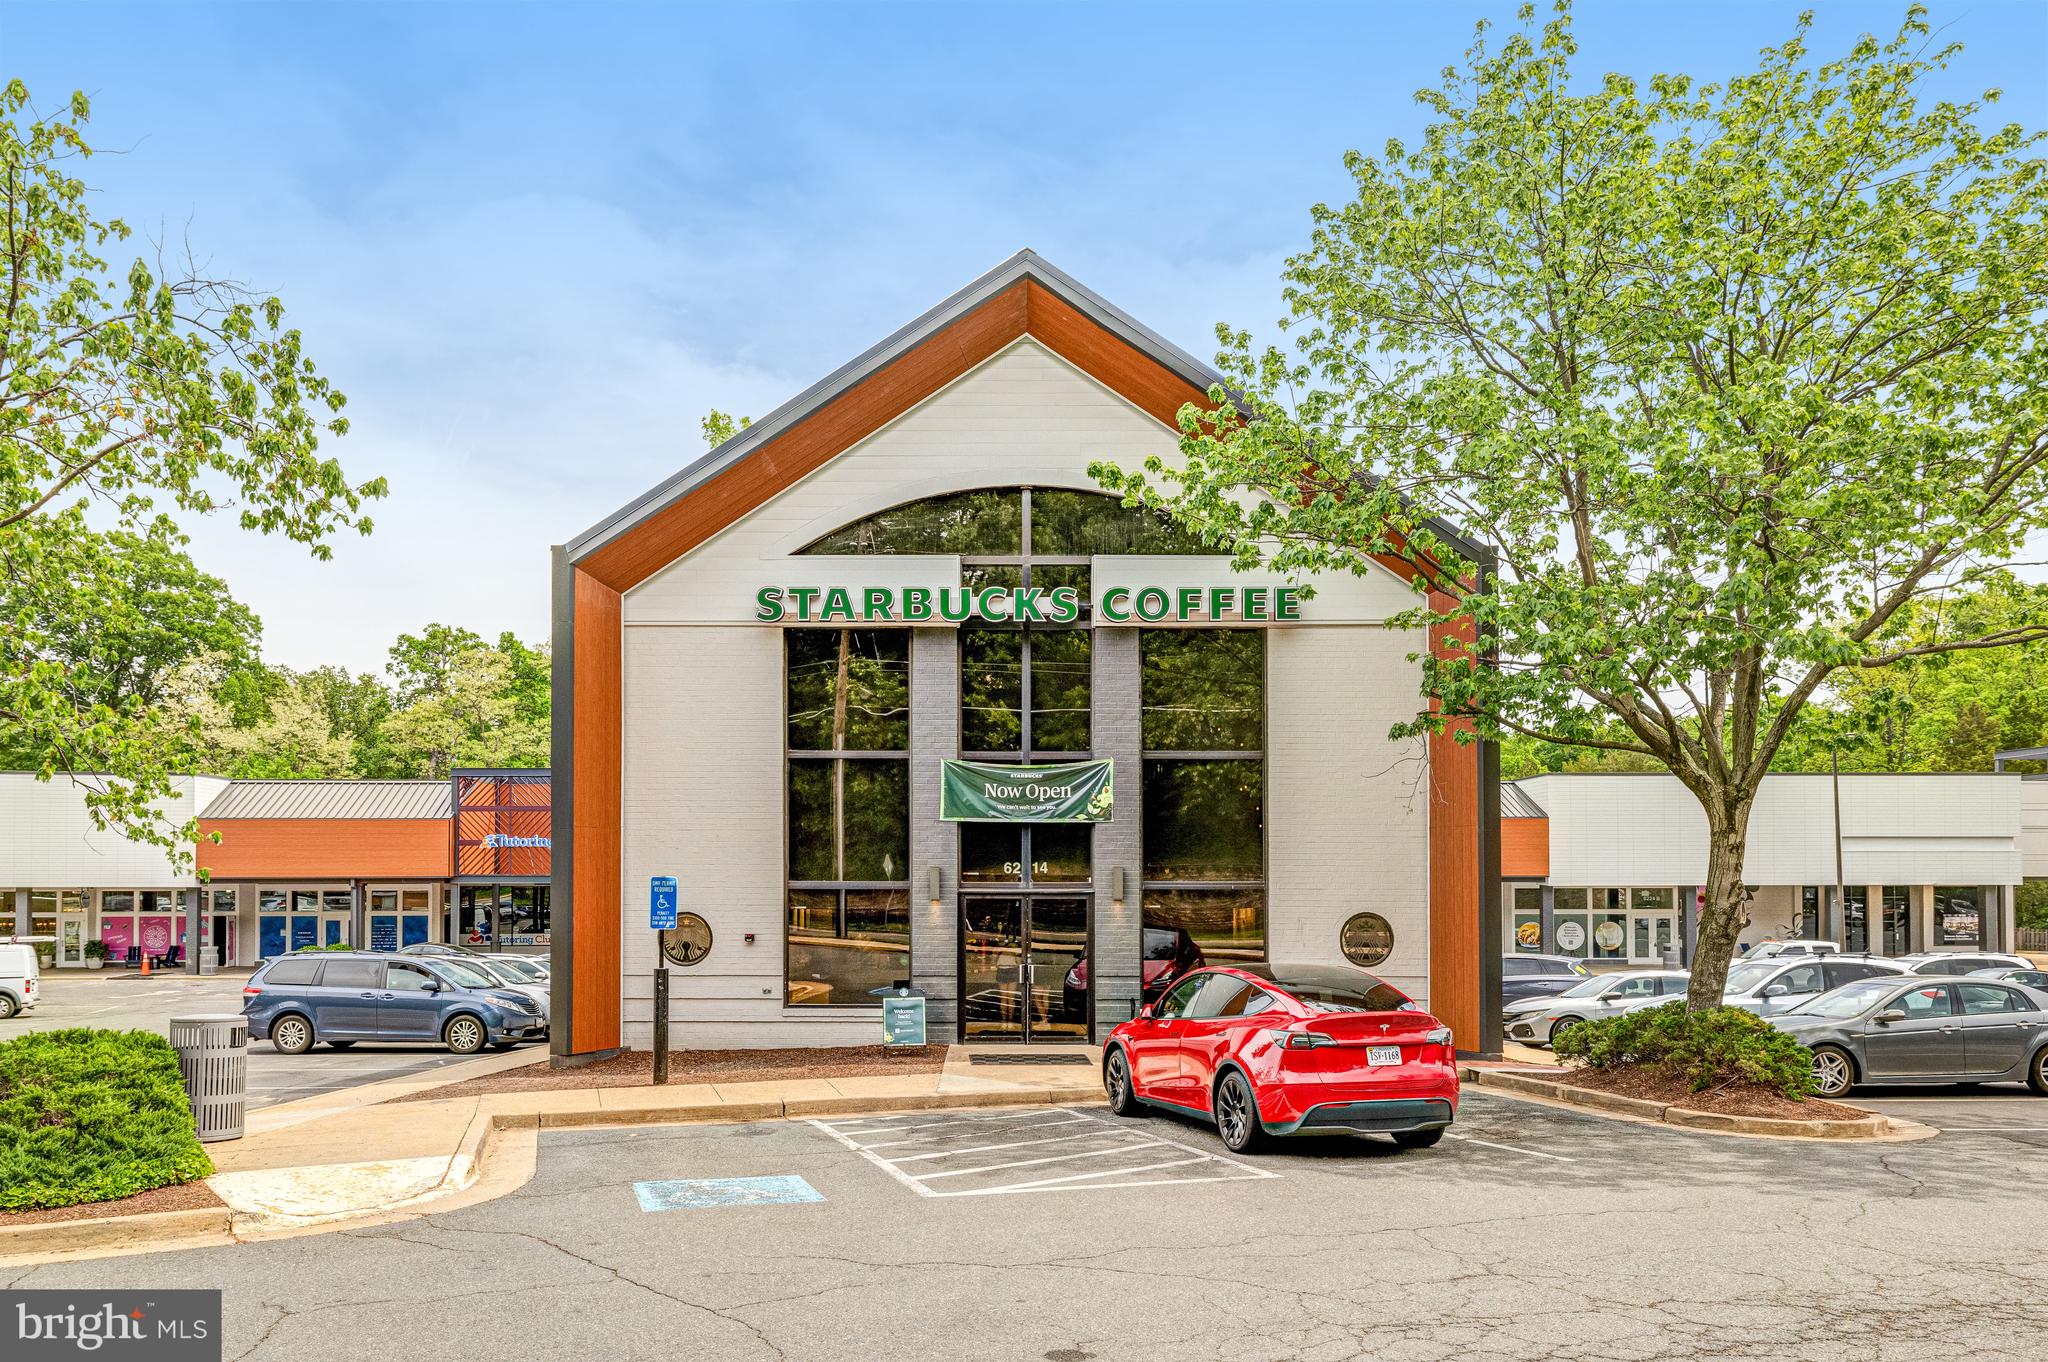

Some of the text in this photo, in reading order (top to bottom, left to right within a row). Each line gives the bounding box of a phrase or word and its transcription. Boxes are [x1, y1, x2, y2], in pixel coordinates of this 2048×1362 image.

[755, 585, 1303, 624] STARBUCKS COFFEE
[984, 783, 1072, 802] Now Open
[500, 936, 533, 944] utoring
